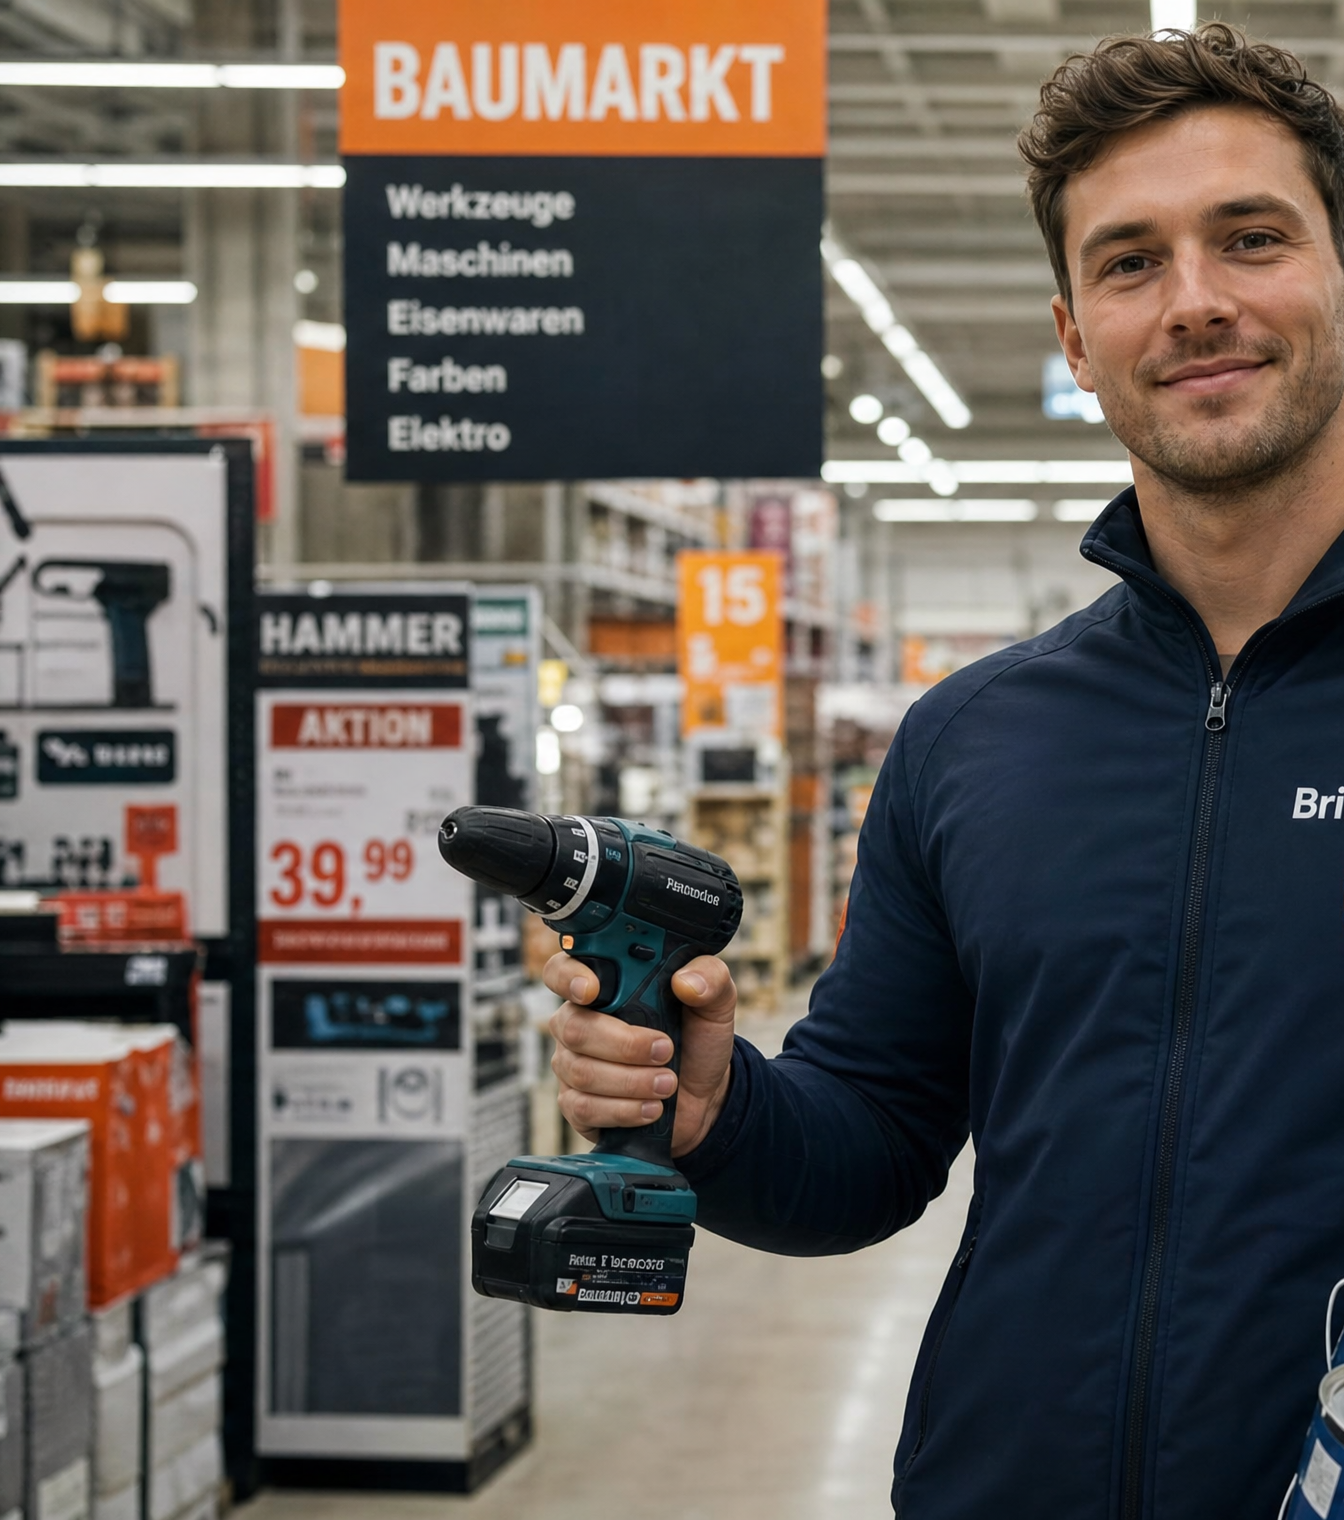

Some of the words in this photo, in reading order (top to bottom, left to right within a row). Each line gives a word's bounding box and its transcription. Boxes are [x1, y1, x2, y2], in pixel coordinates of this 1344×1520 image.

[375, 41, 785, 122] BAUMARKT
[387, 184, 575, 227] Werkzeuge
[387, 241, 573, 278] Maschinen
[387, 300, 584, 335] Eisenwaren
[388, 357, 507, 393] Farben
[388, 415, 511, 452] Elektro
[697, 565, 767, 627] 15
[260, 612, 463, 656] HAMMER
[299, 708, 432, 744] AKTION
